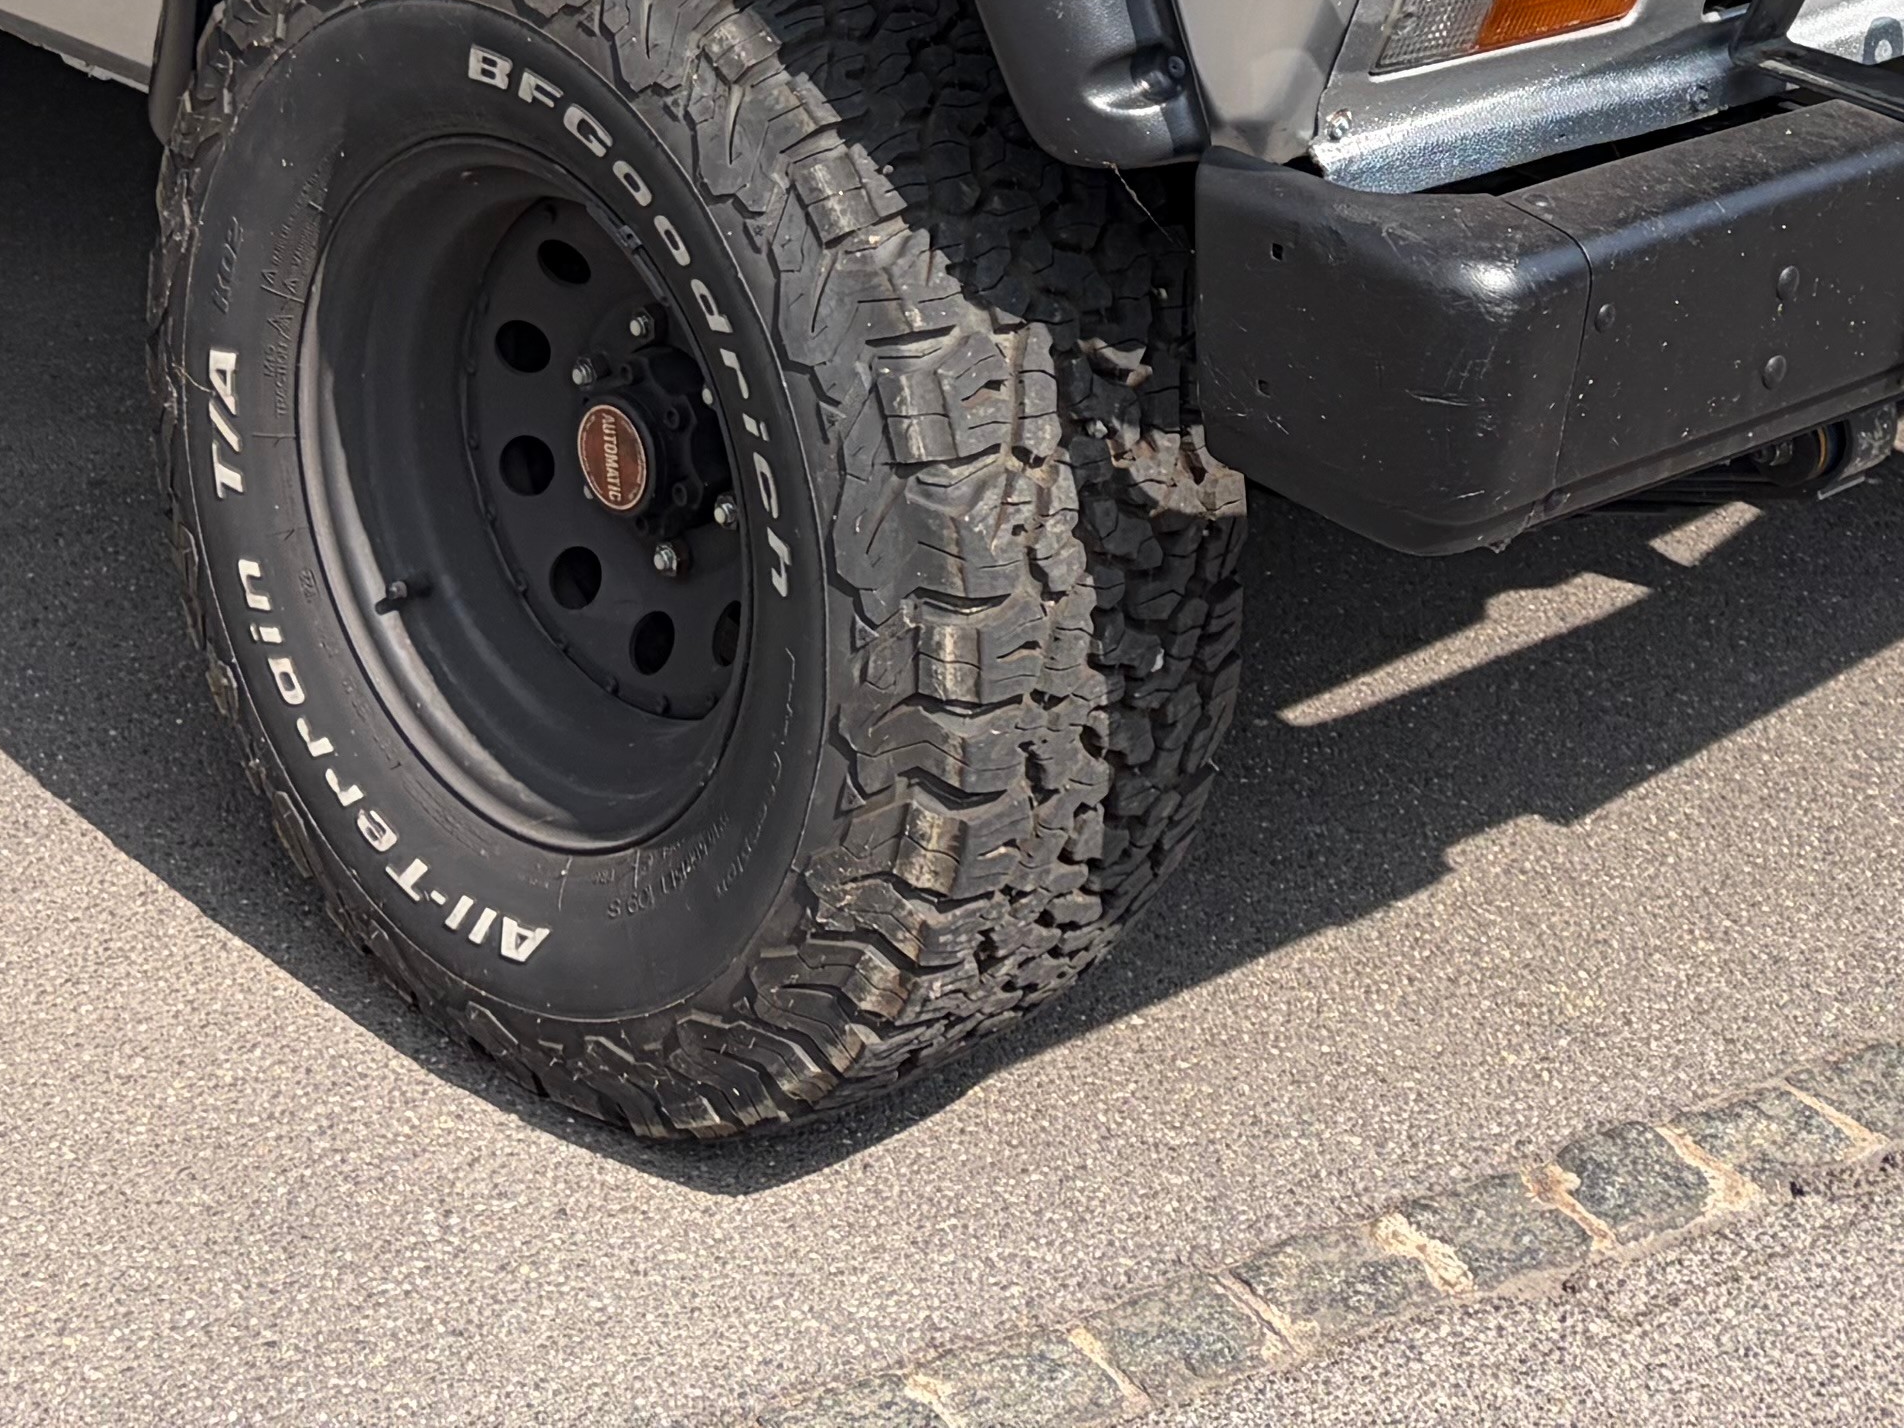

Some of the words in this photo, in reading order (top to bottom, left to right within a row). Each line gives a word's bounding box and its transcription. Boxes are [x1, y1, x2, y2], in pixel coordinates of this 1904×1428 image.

[208, 350, 246, 498] T/A
[467, 44, 793, 598] BFGoodrich
[601, 412, 621, 502] AUTOMATIC
[237, 558, 551, 963] All-Terrain
